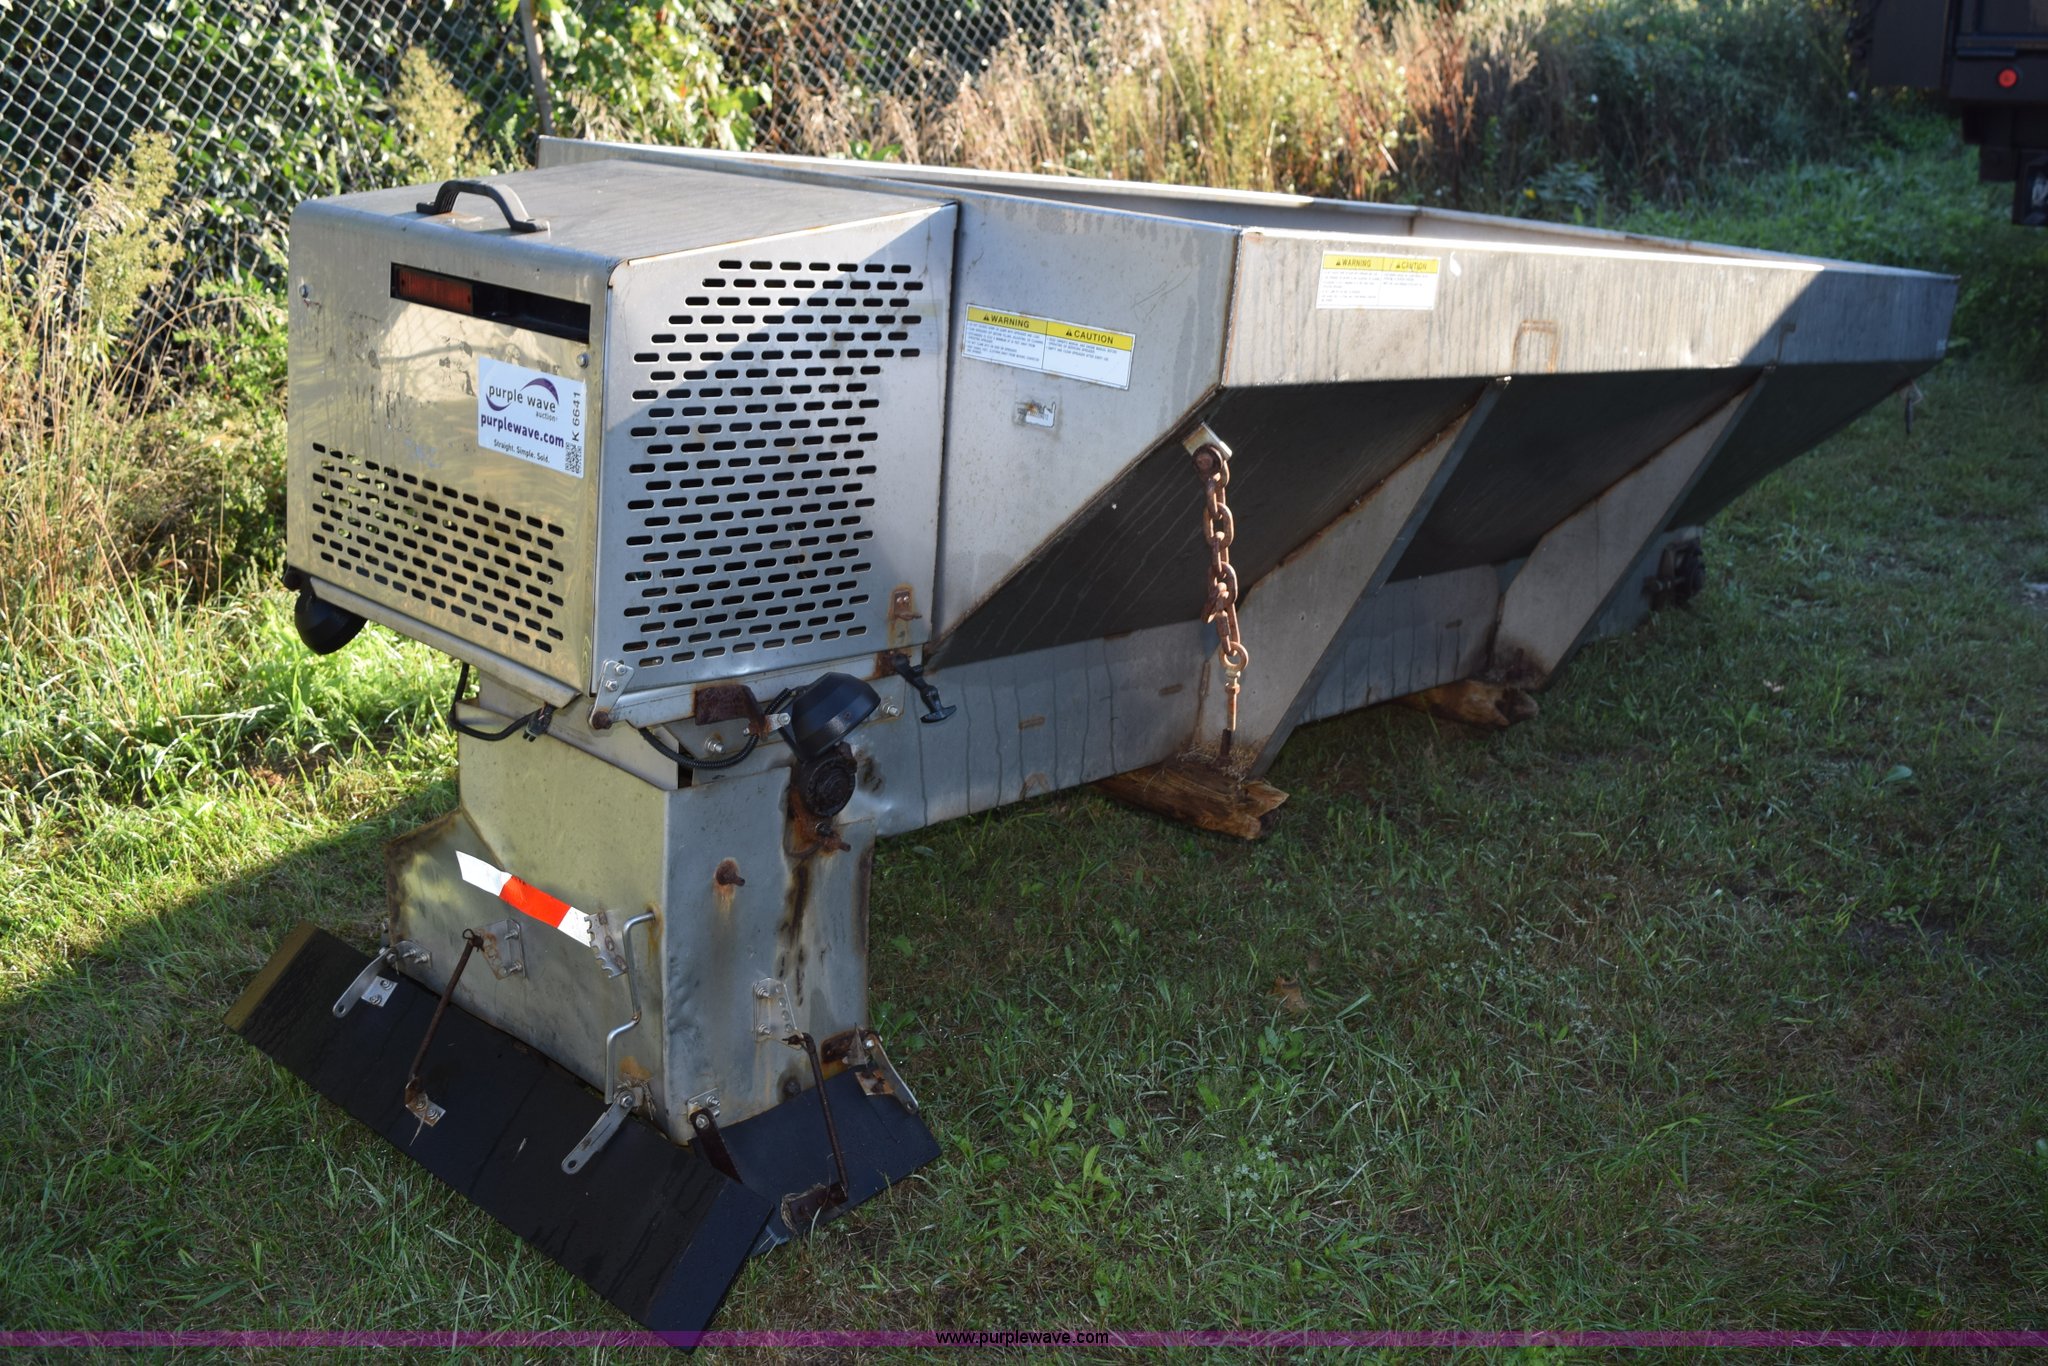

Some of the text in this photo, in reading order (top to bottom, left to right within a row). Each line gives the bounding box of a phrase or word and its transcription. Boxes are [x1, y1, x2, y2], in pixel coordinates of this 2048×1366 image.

[1342, 258, 1371, 268] WARNING
[1401, 261, 1427, 270] CAUTION
[991, 314, 1030, 328] WARNING
[1074, 330, 1113, 344] CAUTION
[489, 385, 556, 413] purple wave
[536, 411, 556, 422] auction
[572, 392, 581, 442] K 6641
[481, 414, 565, 448] purplewave.com
[493, 438, 550, 464] Straight. Simple. Sold.
